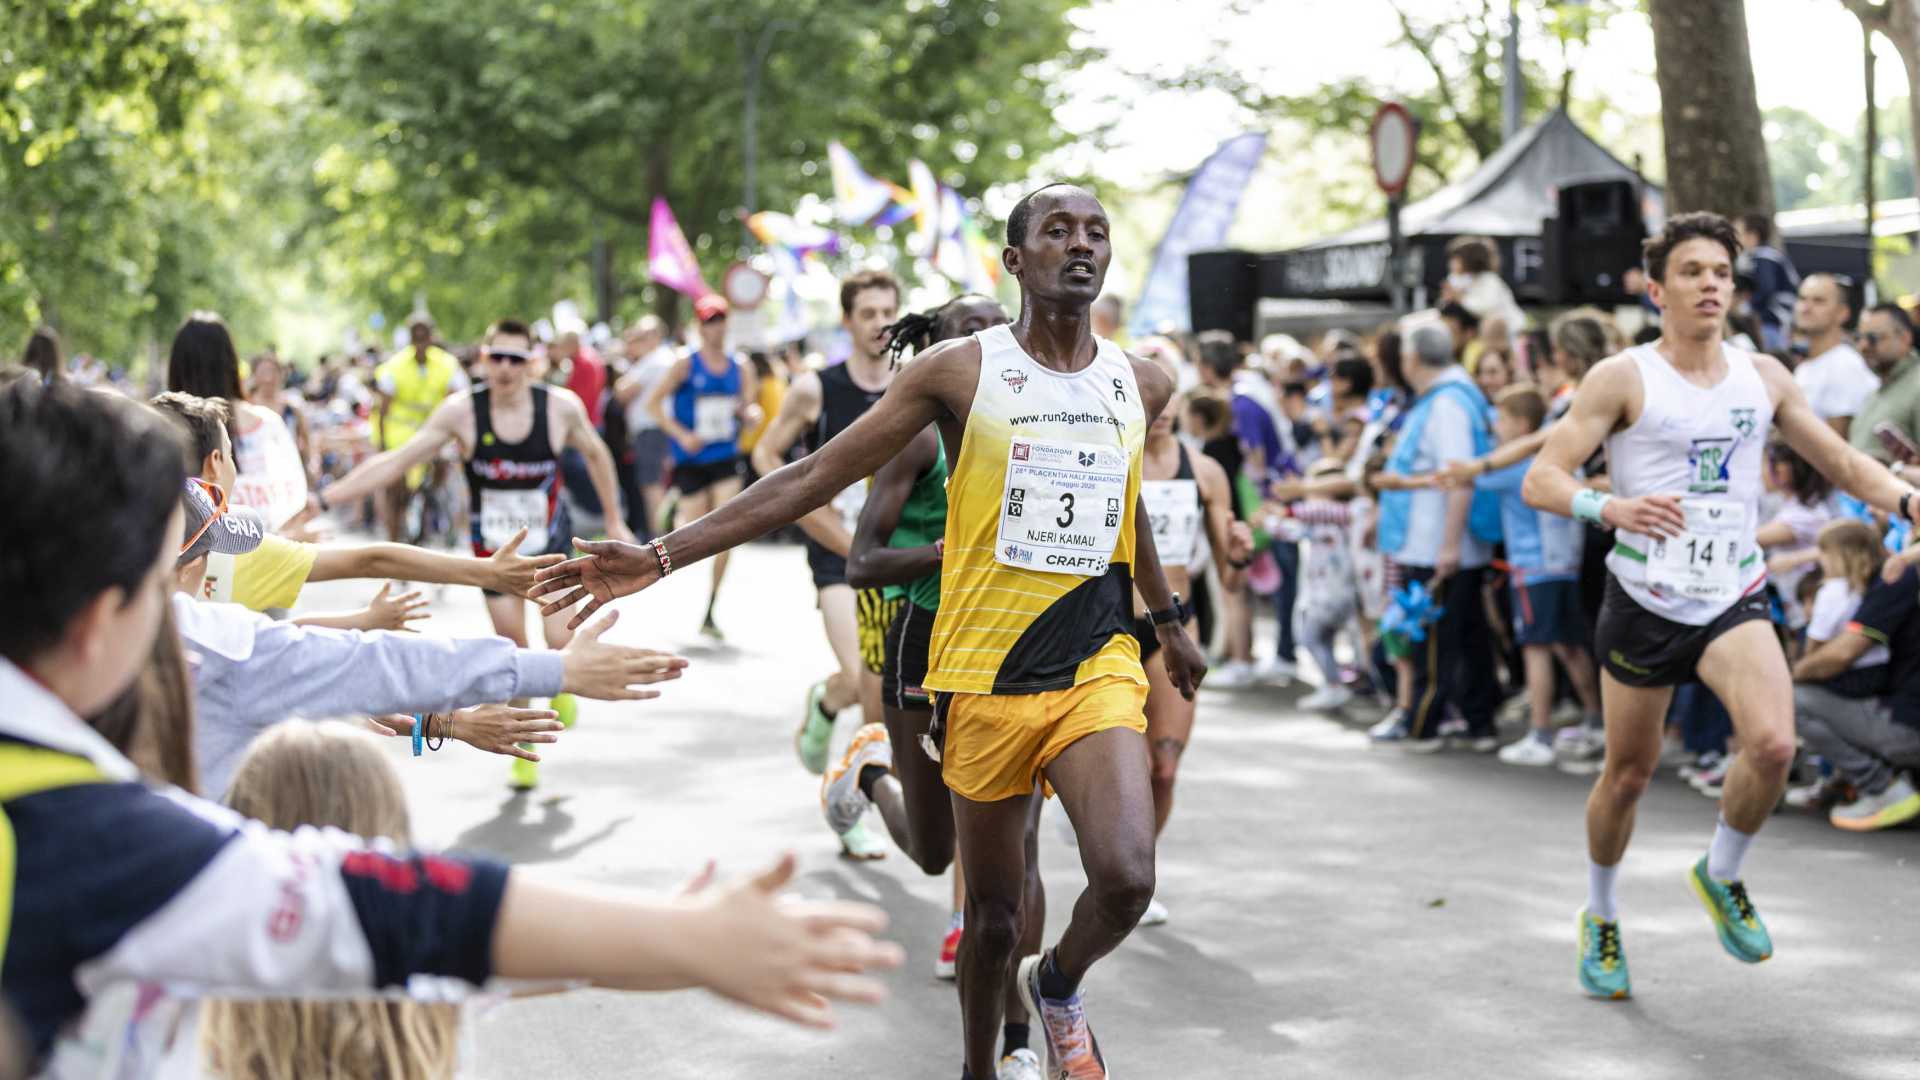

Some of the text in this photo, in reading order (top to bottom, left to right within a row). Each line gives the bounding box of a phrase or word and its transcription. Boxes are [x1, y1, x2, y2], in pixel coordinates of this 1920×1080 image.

[1032, 446, 1073, 456] FONDAZIONE
[1028, 468, 1068, 479] PLACENTIA
[1068, 472, 1087, 481] HALF
[1088, 474, 1122, 484] MARATHON
[1056, 492, 1075, 529] 3
[1026, 529, 1096, 547] NJERI KAMAU
[1046, 554, 1097, 568] CRAFT
[1686, 539, 1714, 566] 14
